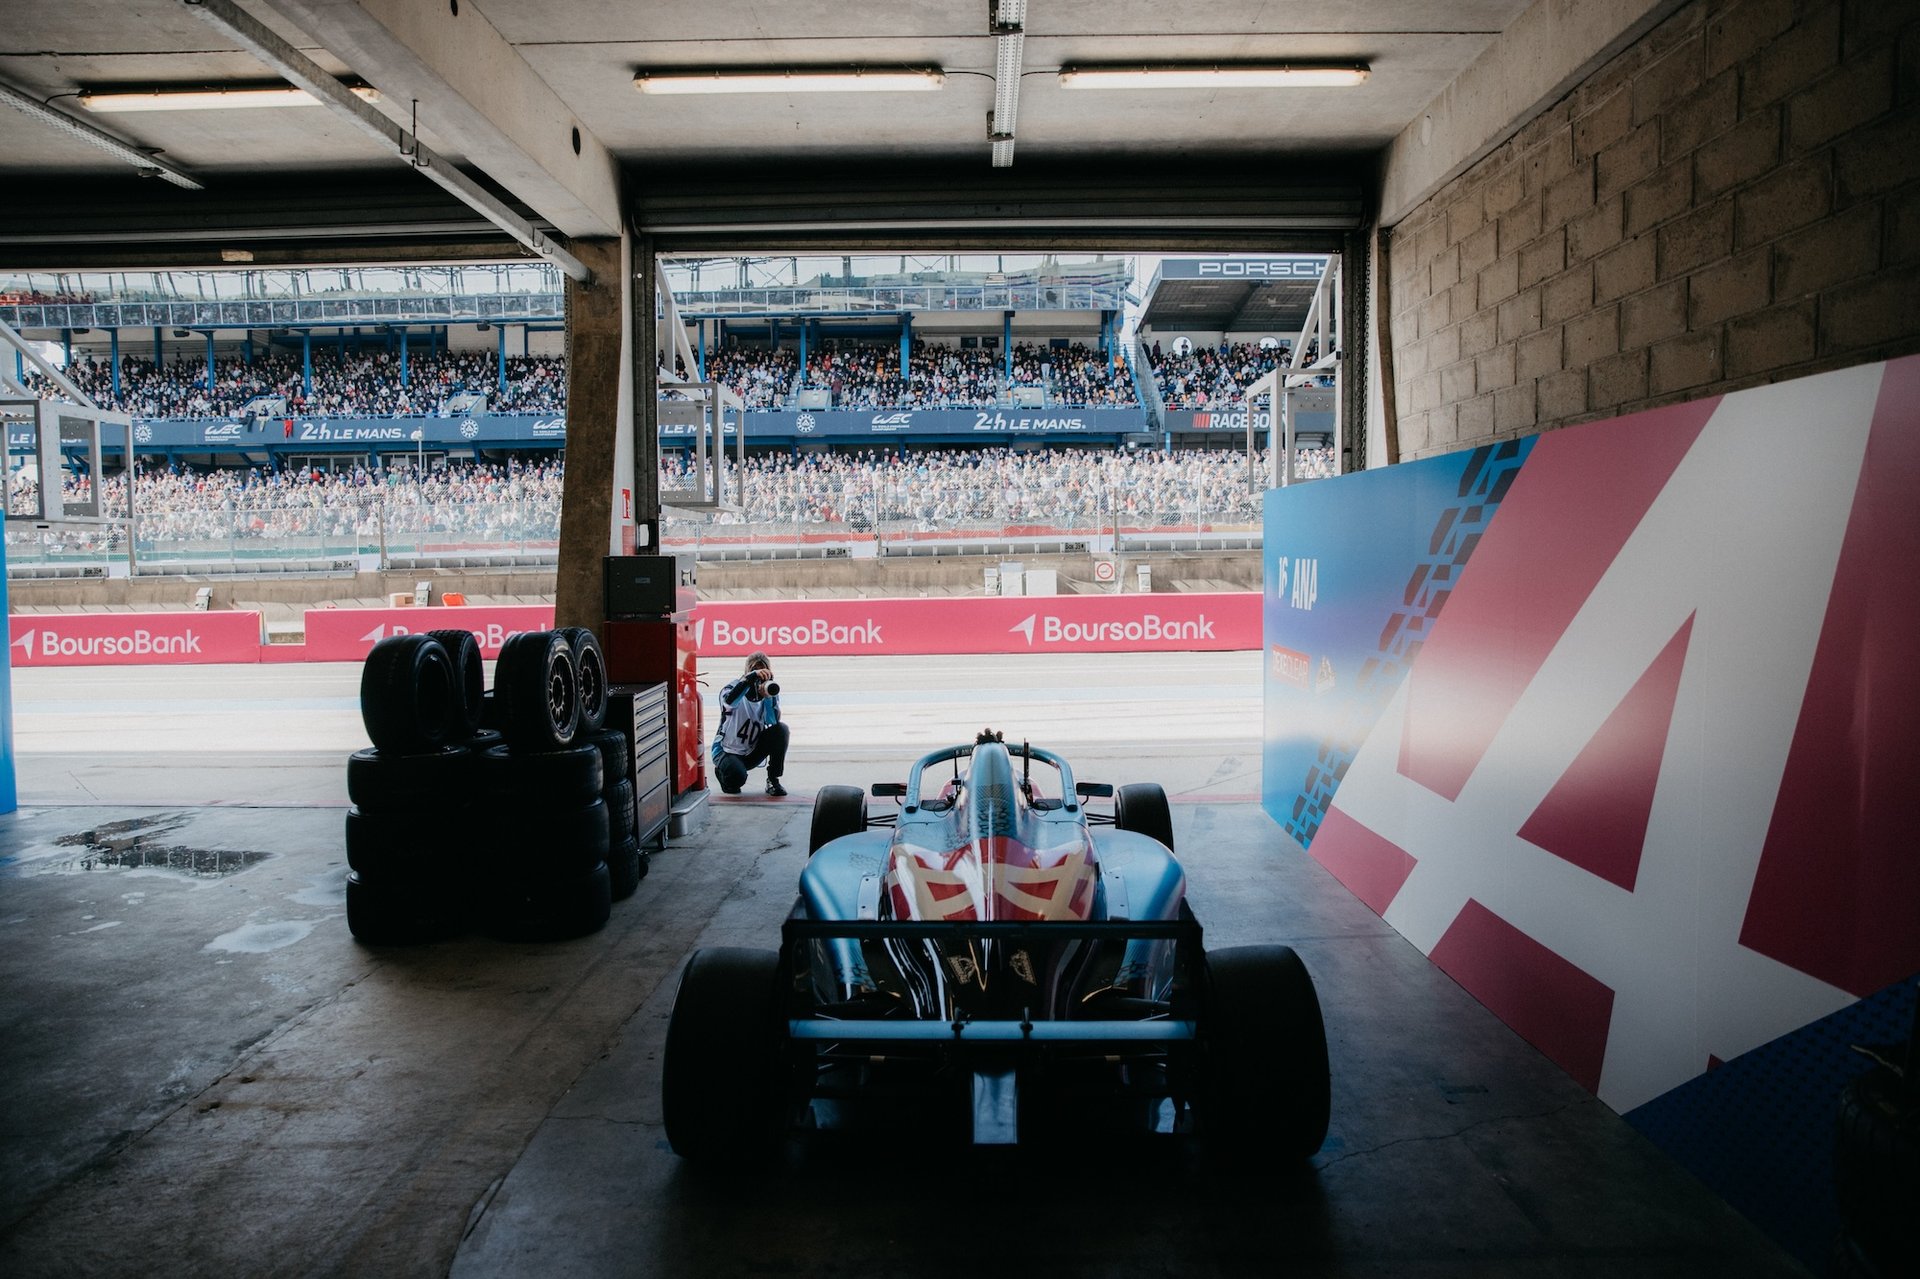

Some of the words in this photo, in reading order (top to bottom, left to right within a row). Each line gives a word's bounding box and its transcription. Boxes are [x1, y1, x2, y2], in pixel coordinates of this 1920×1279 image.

[664, 424, 685, 434] LE
[1009, 419, 1031, 430] LE
[10, 433, 31, 444] LE
[333, 428, 354, 440] LE
[713, 618, 884, 646] BoursoBank
[1043, 614, 1216, 642] BoursoBank
[42, 628, 202, 656] BoursoBank
